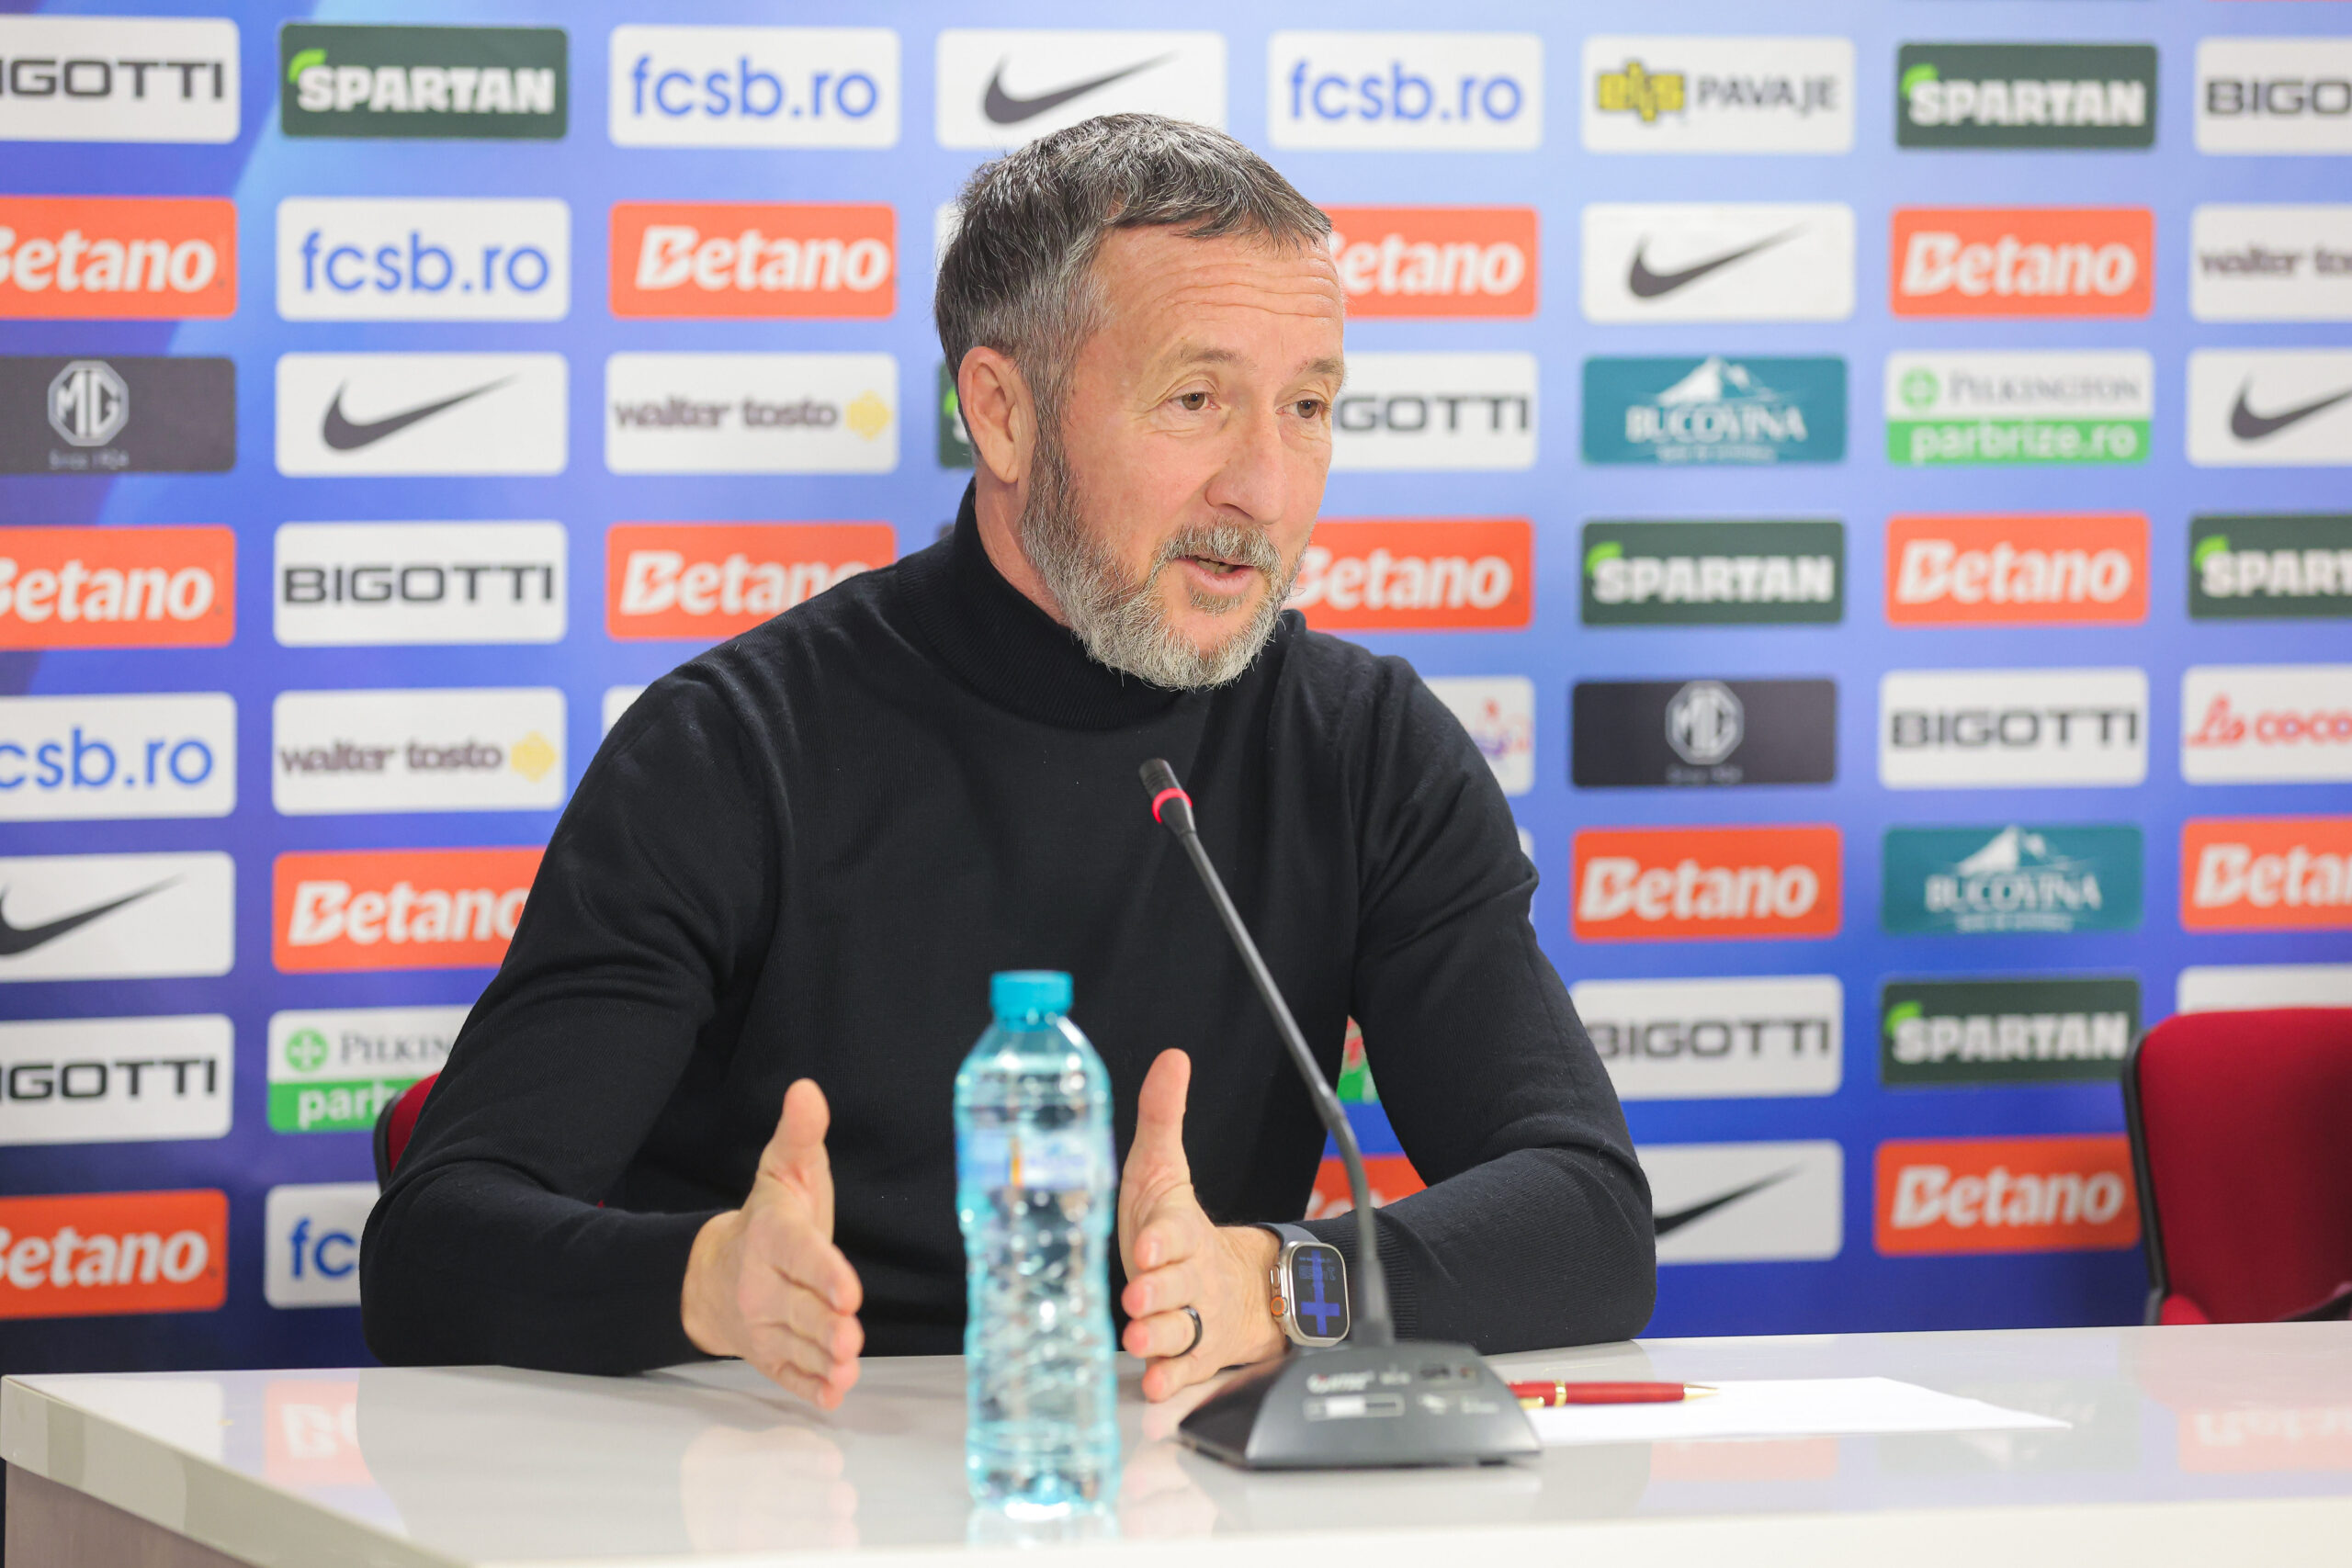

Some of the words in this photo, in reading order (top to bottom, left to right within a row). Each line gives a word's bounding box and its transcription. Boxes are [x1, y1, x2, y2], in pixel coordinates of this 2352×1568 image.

[0, 58, 223, 100] GOTTI
[297, 65, 556, 114] SPARTAN
[630, 53, 879, 120] fcsb.ro
[1286, 61, 1525, 122] fcsb.ro
[1697, 73, 1838, 116] PAVAJE
[1908, 79, 2147, 127] SPARTAN
[0, 226, 217, 293] etano
[301, 228, 550, 294] fcsb.ro
[635, 225, 889, 292] Betano
[1899, 231, 2137, 297] Betano
[52, 364, 125, 443] MG
[1948, 370, 2139, 402] PILKINGTON
[1332, 395, 1532, 435] GOTTI
[1624, 403, 1808, 445] BUCOVINA
[1910, 419, 2139, 463] parbrize.ro
[283, 561, 555, 604] BIGOTTI
[1591, 555, 1836, 604] SPARTAN
[1894, 538, 2132, 604] Betano
[1890, 706, 2140, 749] BIGOTTI
[1576, 856, 1820, 923] Betano
[1924, 874, 2103, 914] BUCOVINA
[2191, 841, 2352, 909] Beta
[1892, 1012, 2130, 1064] SPARTAN
[0, 1059, 217, 1101] GOTTI
[1890, 1165, 2126, 1229] Betano
[0, 1225, 209, 1290] etano
